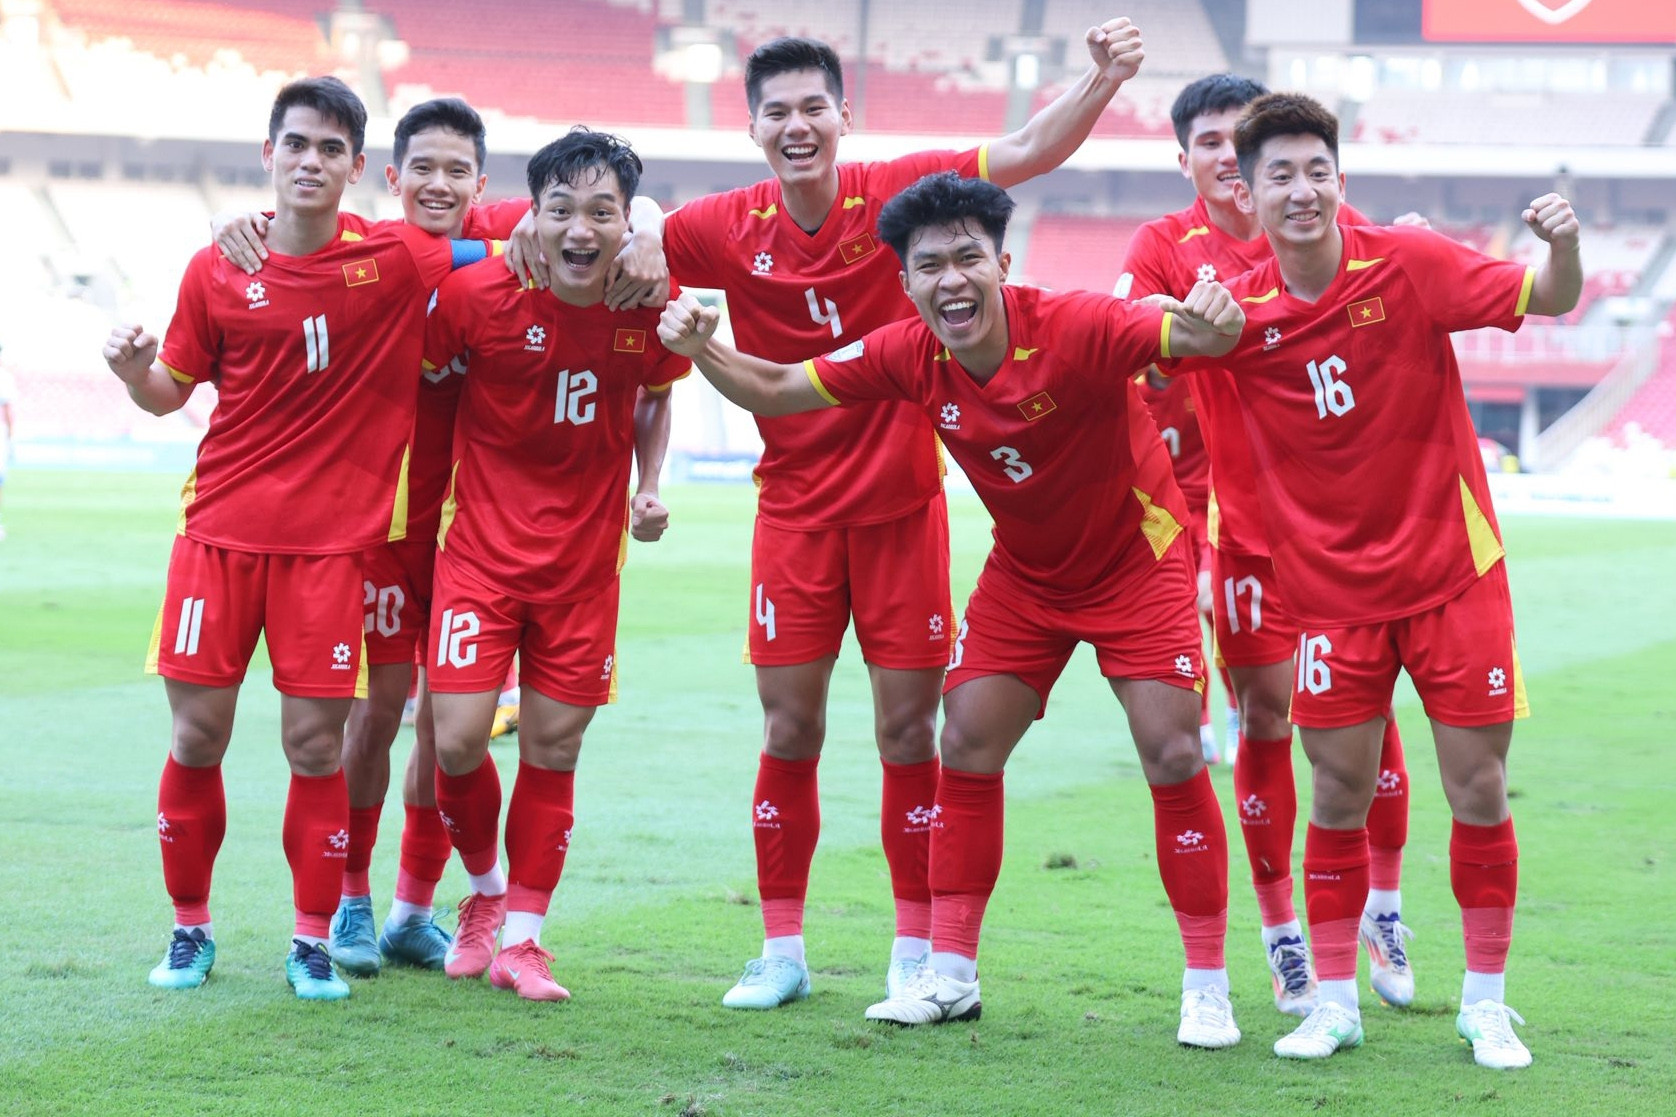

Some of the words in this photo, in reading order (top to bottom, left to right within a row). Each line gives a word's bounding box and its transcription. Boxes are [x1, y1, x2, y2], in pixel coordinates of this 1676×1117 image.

[804, 286, 843, 339] 4
[302, 313, 329, 374] 11
[554, 369, 598, 426] 12
[1306, 354, 1355, 420] 16
[990, 445, 1033, 484] 3
[174, 597, 205, 656] 11
[756, 583, 776, 642] 4
[1224, 575, 1262, 635] 17
[437, 608, 480, 669] 12
[1297, 632, 1332, 696] 16
